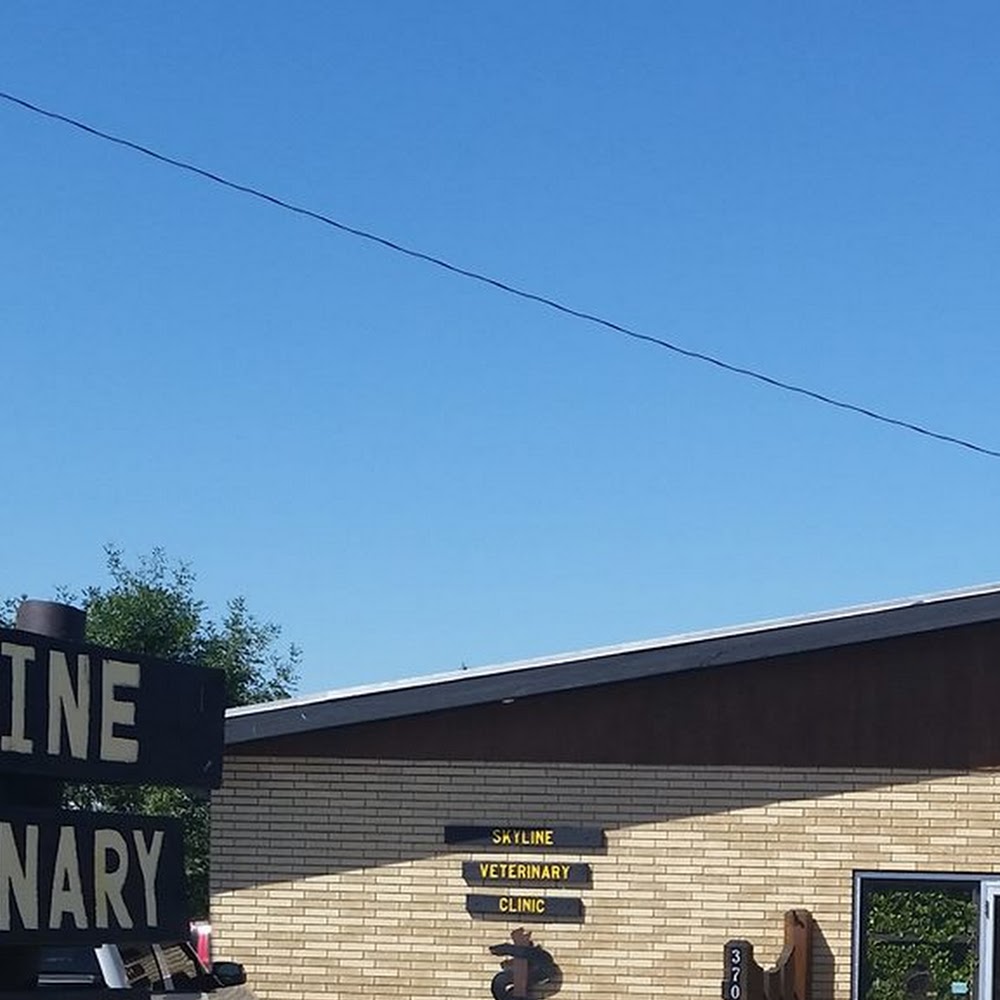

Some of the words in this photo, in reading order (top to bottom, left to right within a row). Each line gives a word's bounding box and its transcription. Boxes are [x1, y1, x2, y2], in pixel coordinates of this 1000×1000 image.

[0, 642, 141, 764] INE
[492, 829, 554, 845] SKYLINE
[479, 863, 571, 880] VETERINARY
[499, 897, 546, 913] CLINIC
